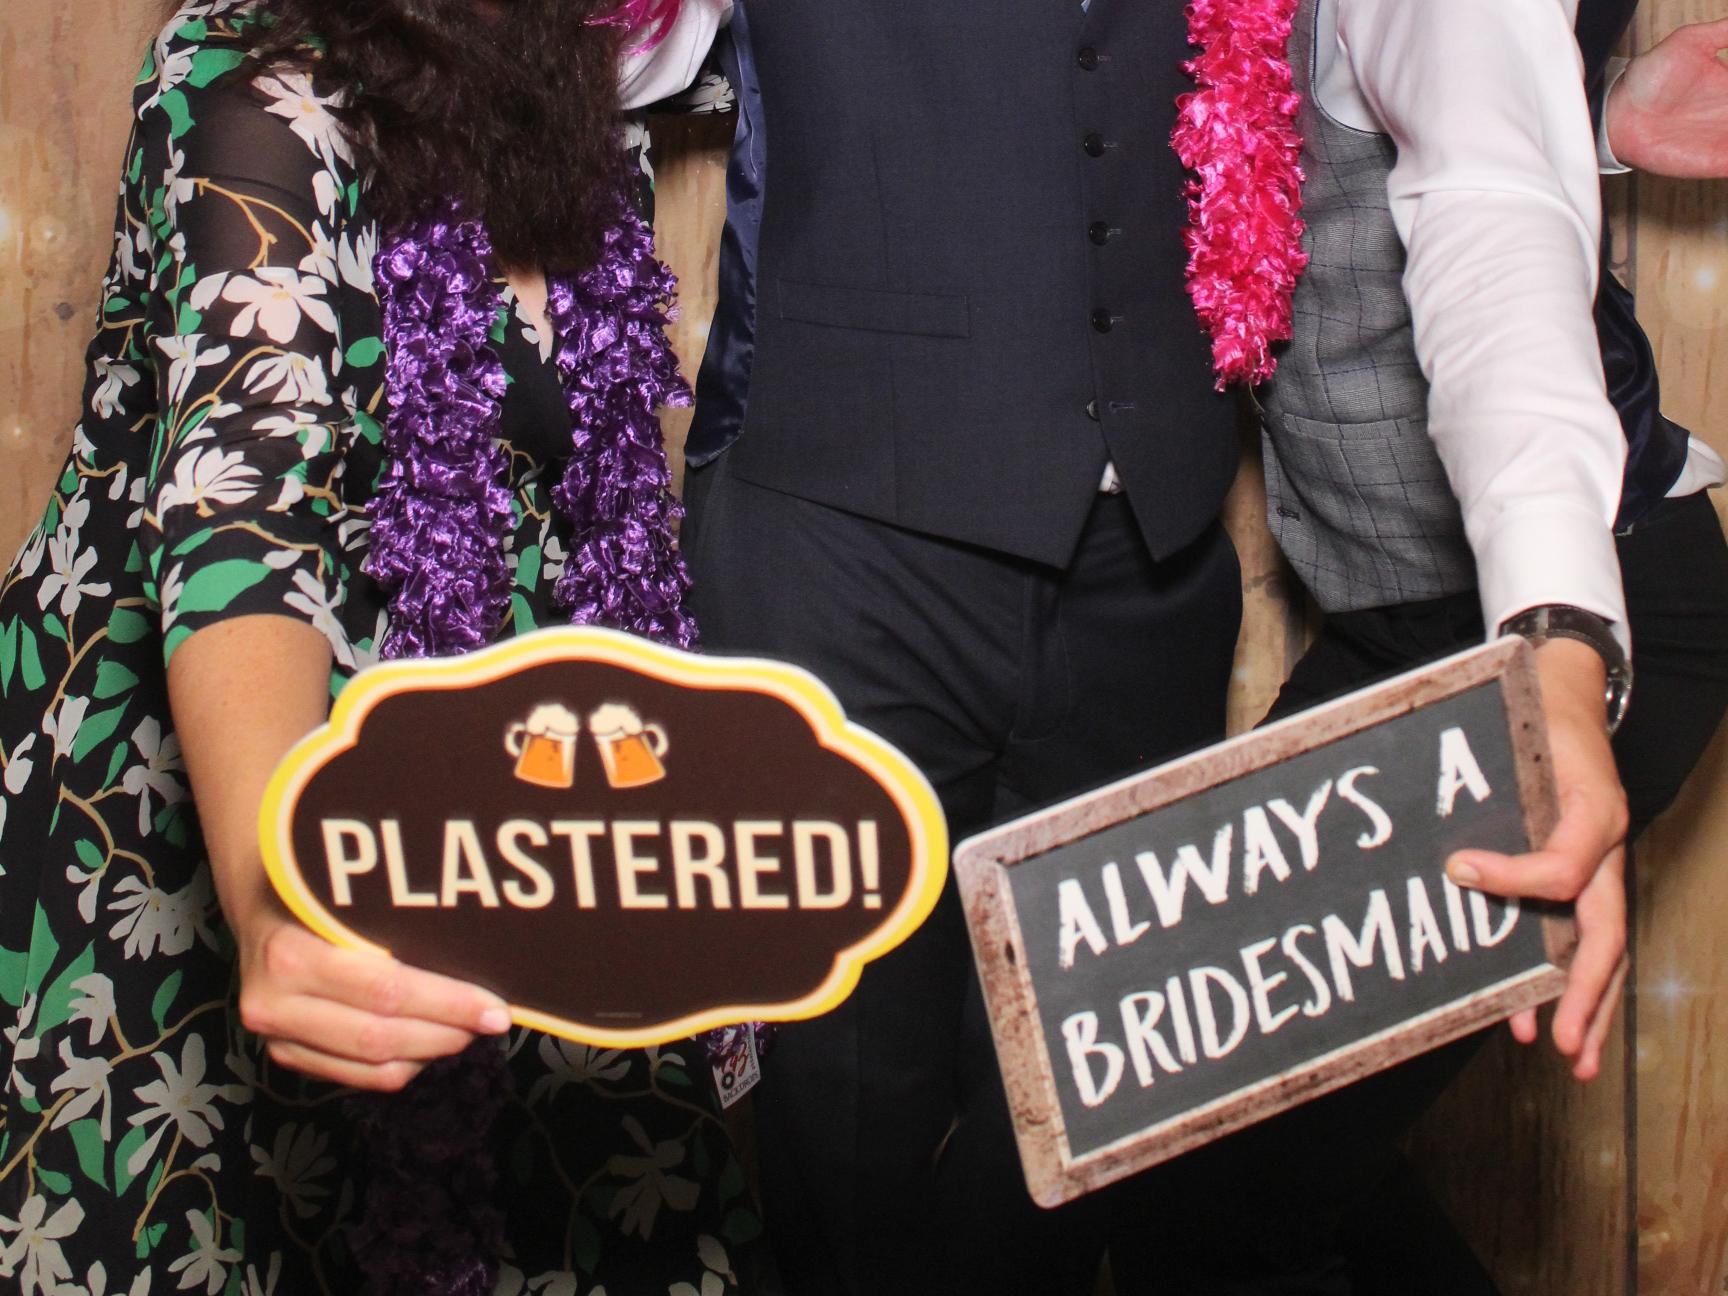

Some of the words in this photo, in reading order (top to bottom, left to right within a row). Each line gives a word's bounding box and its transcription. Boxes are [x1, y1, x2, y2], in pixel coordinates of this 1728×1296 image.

[321, 818, 882, 910] PLASTERED!
[1057, 764, 1393, 969] ALWAYS
[1437, 726, 1492, 816] A
